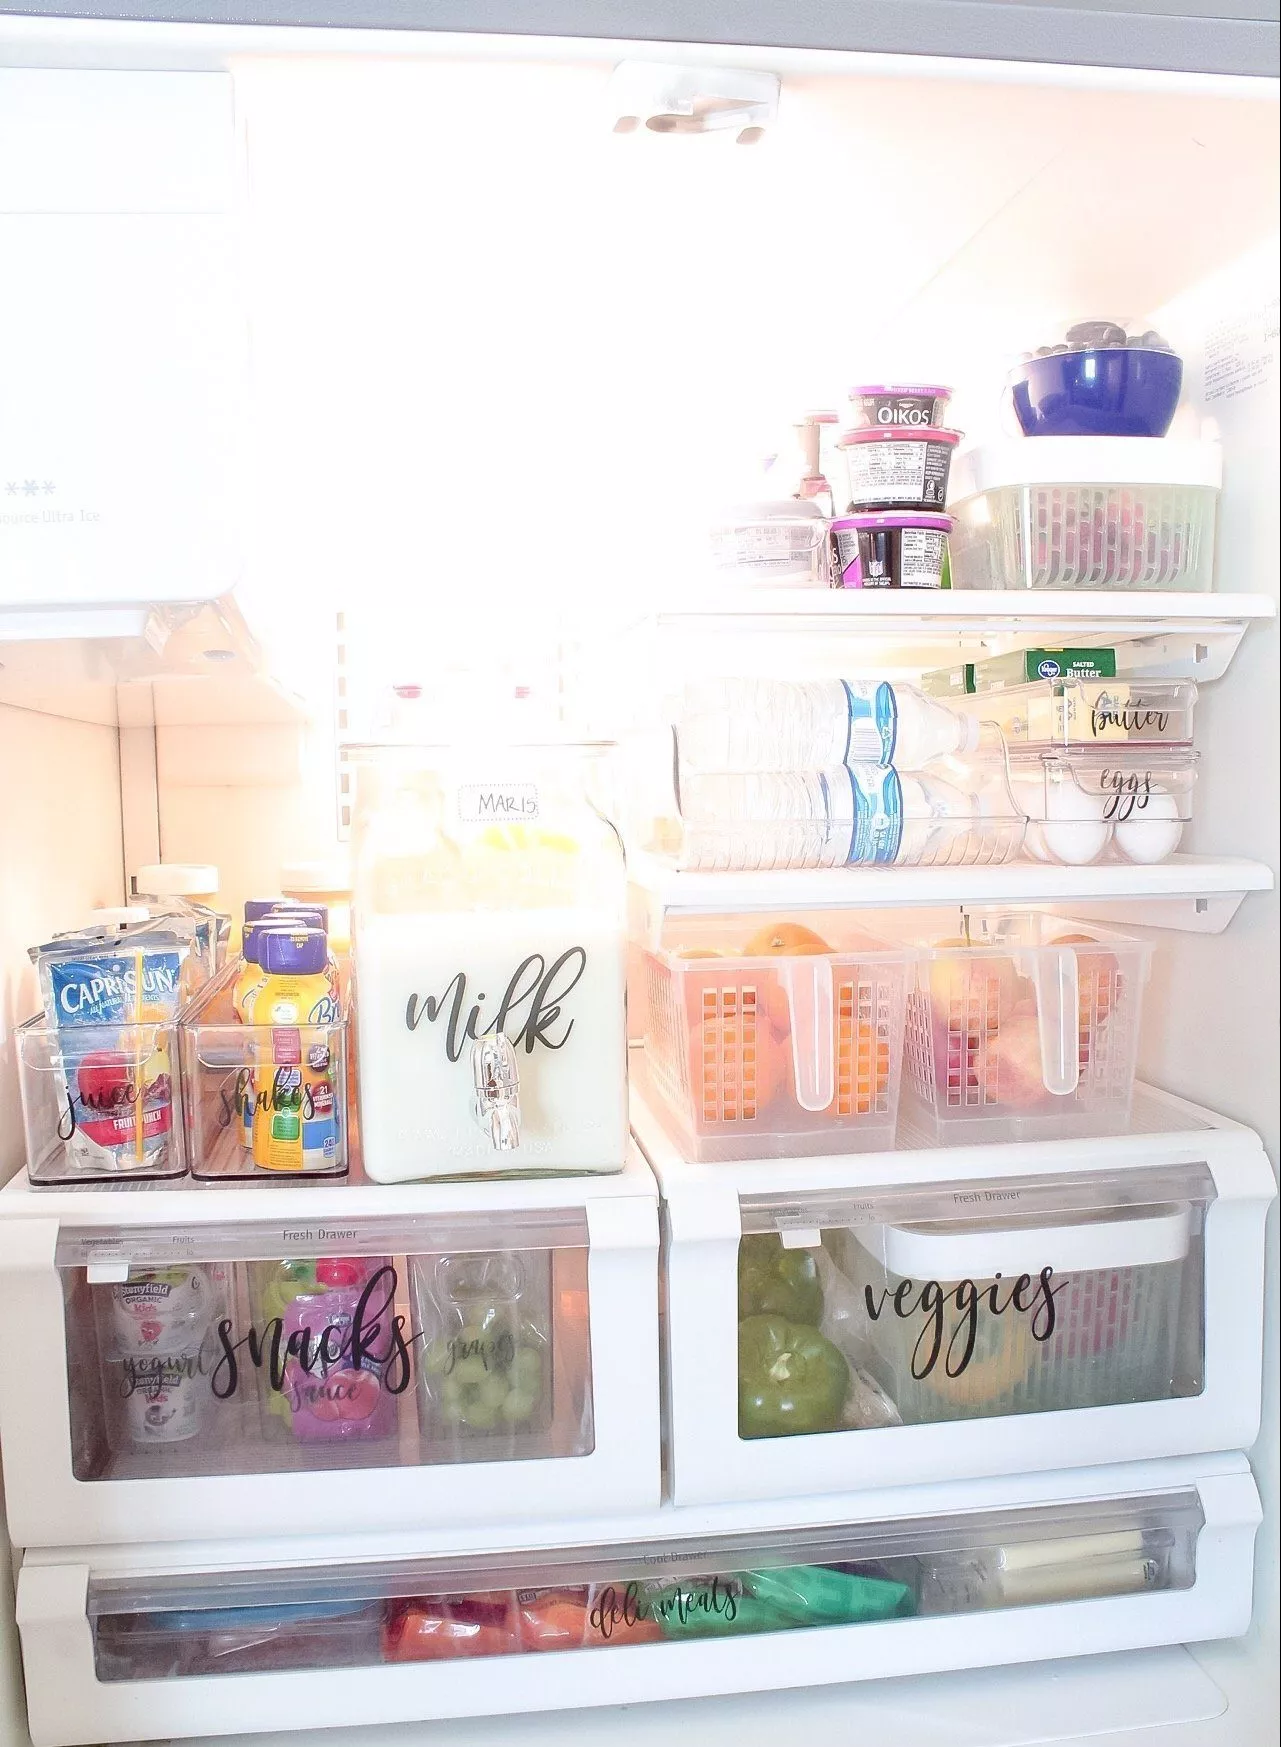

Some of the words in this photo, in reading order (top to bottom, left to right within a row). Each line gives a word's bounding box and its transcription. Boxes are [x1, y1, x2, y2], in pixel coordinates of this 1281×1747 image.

[878, 406, 929, 425] OIKOS
[42, 509, 74, 523] Ultra
[80, 508, 100, 522] Ice
[1066, 668, 1102, 678] Butter
[1099, 767, 1159, 821] eggs
[405, 945, 587, 1063] milk
[219, 1066, 316, 1127] shakes
[57, 1085, 141, 1141] juice
[113, 1116, 137, 1131] FRUIT
[952, 1193, 981, 1204] Fresh
[985, 1189, 1021, 1202] Drawer
[172, 1235, 195, 1245] Fruits
[282, 1229, 312, 1241] Fresh
[317, 1227, 358, 1241] Drawer
[125, 1296, 161, 1304] ORGANIC
[864, 1265, 1070, 1380] veggies
[211, 1265, 426, 1400] snacks
[589, 1582, 649, 1639] deli
[660, 1575, 741, 1625] meats
